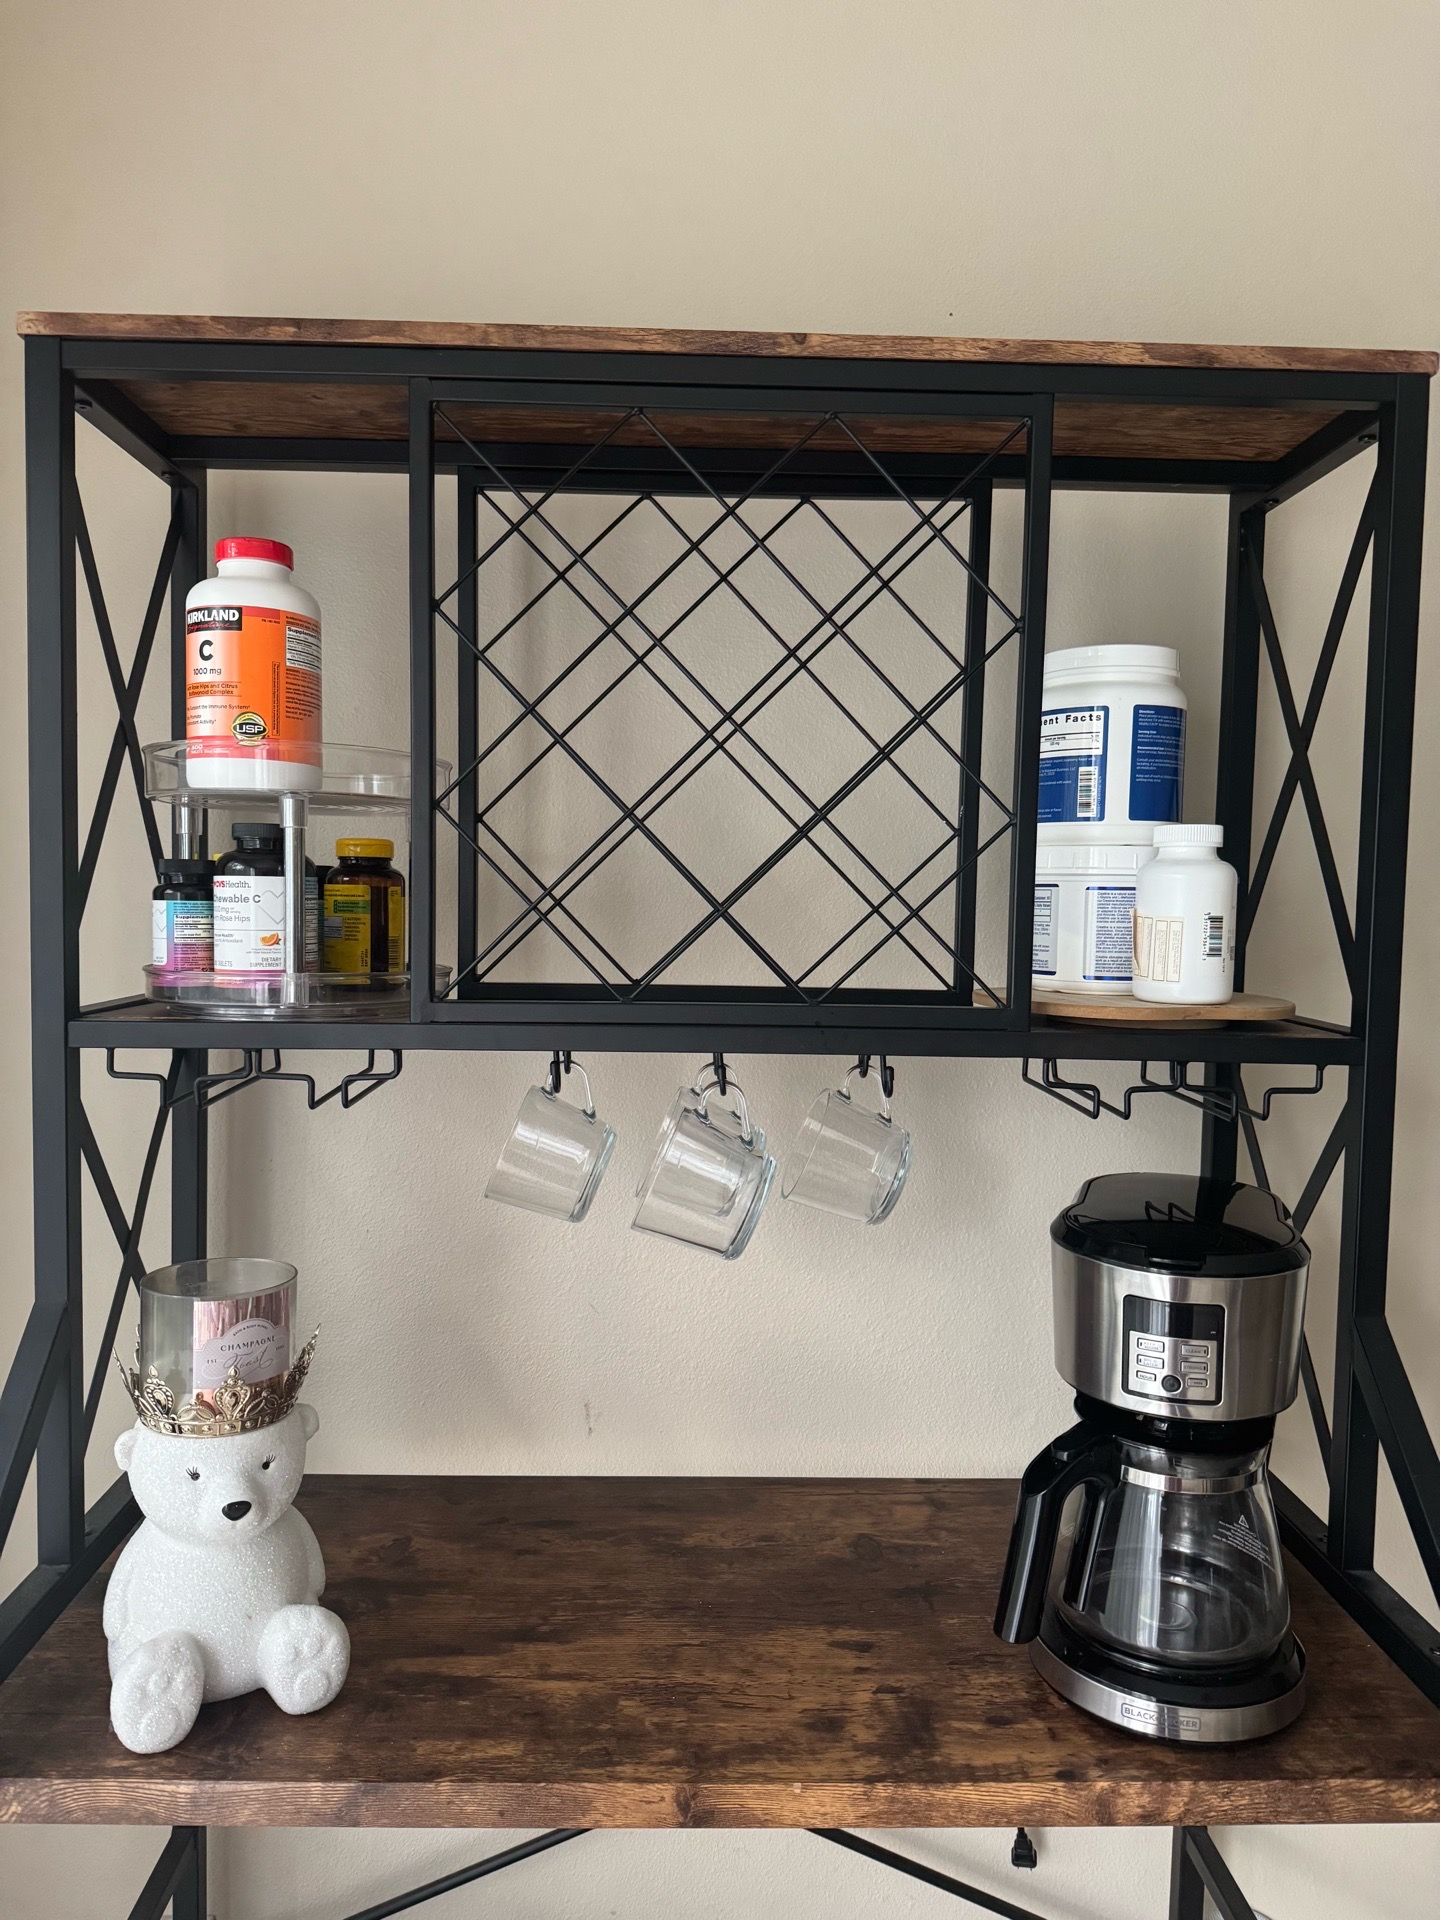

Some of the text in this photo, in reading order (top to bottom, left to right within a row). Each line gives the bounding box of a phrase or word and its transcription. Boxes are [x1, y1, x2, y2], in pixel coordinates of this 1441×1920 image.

[187, 609, 239, 624] KIRKLAND
[199, 639, 214, 661] C
[193, 667, 222, 676] 1000 mg
[210, 688, 235, 696] Complex
[1065, 714, 1103, 724] Facts
[236, 723, 265, 735] USP
[252, 894, 262, 904] C
[234, 915, 251, 924] Hips
[220, 1335, 275, 1352] CHAMPAGNE
[1124, 1707, 1198, 1728] BLACK+CKER
